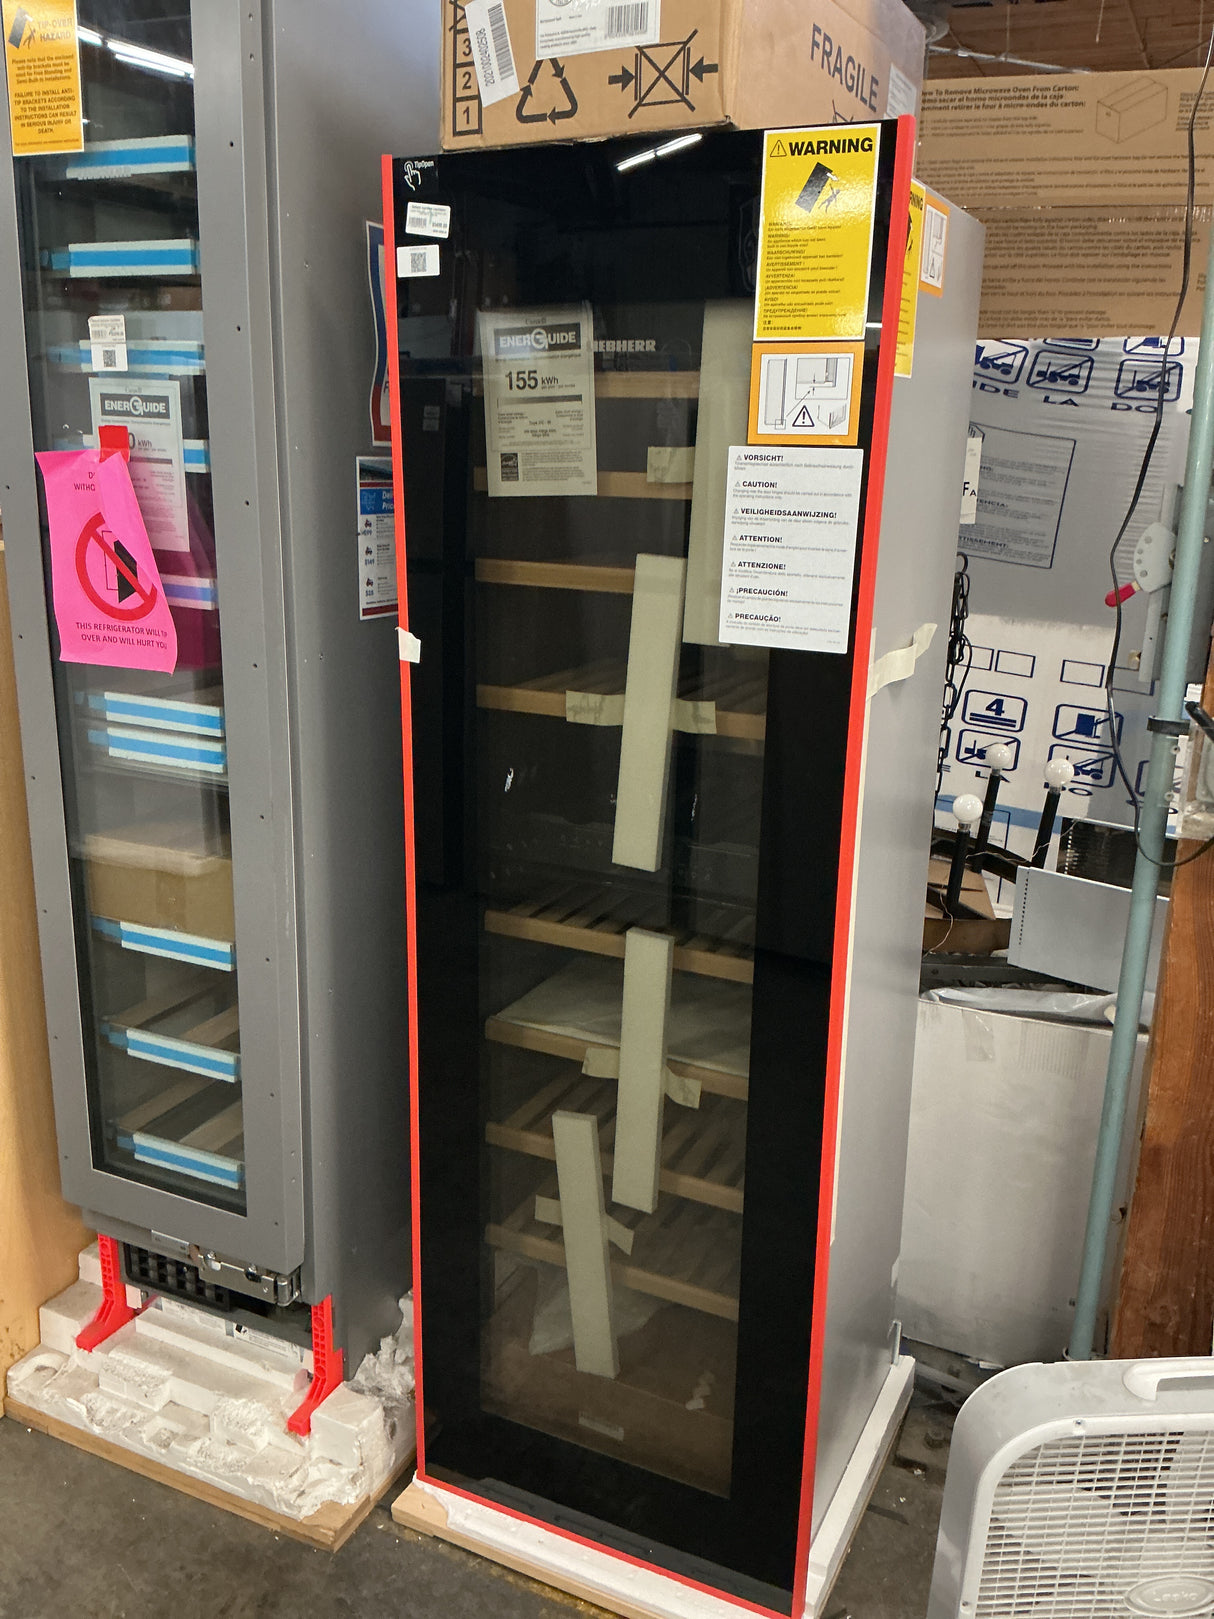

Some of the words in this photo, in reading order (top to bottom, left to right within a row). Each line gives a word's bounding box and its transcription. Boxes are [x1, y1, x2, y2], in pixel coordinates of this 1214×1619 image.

[40, 30, 71, 41] HAZARD
[463, 38, 471, 56] 3
[811, 22, 879, 113] FRAGILE
[462, 72, 472, 90] 2
[973, 86, 1010, 94] Microwave
[1052, 84, 1080, 92] Carton:
[48, 96, 76, 104] ACCORDING
[38, 104, 70, 112] INSTALLATION
[60, 110, 76, 118] RESULT
[463, 106, 470, 124] 1
[788, 137, 874, 156] WARNING
[415, 160, 434, 168] TipOpen
[500, 328, 576, 351] ENERGUIDE
[593, 340, 656, 352] IEBHERR
[505, 370, 539, 390] 155
[541, 376, 559, 385] kWh
[972, 380, 1019, 398] IDE
[104, 396, 166, 416] ENERGUIDE
[128, 432, 136, 450] 0
[138, 439, 152, 447] kWh
[744, 454, 784, 462] VORSICHT!
[88, 472, 95, 480] D
[74, 482, 96, 492] WITHO
[742, 480, 778, 488] CAUTION!
[740, 508, 837, 518] VEILIGHEIDSAANWIJZING!
[738, 534, 783, 543] ATTENTION!
[738, 561, 786, 570] ATTENZIONE!
[736, 587, 788, 596] ¡PRECAUCIÓN!
[735, 612, 782, 623] PRECAUÇÃO!
[76, 622, 92, 630] THIS
[94, 624, 144, 634] REFRIGERATOR
[146, 628, 160, 636] WILL
[81, 634, 100, 642] OVER
[102, 635, 118, 643] AND
[119, 637, 135, 646] WILL
[136, 638, 154, 647] HURT
[156, 641, 168, 650] YOU
[986, 698, 1005, 716] 4
